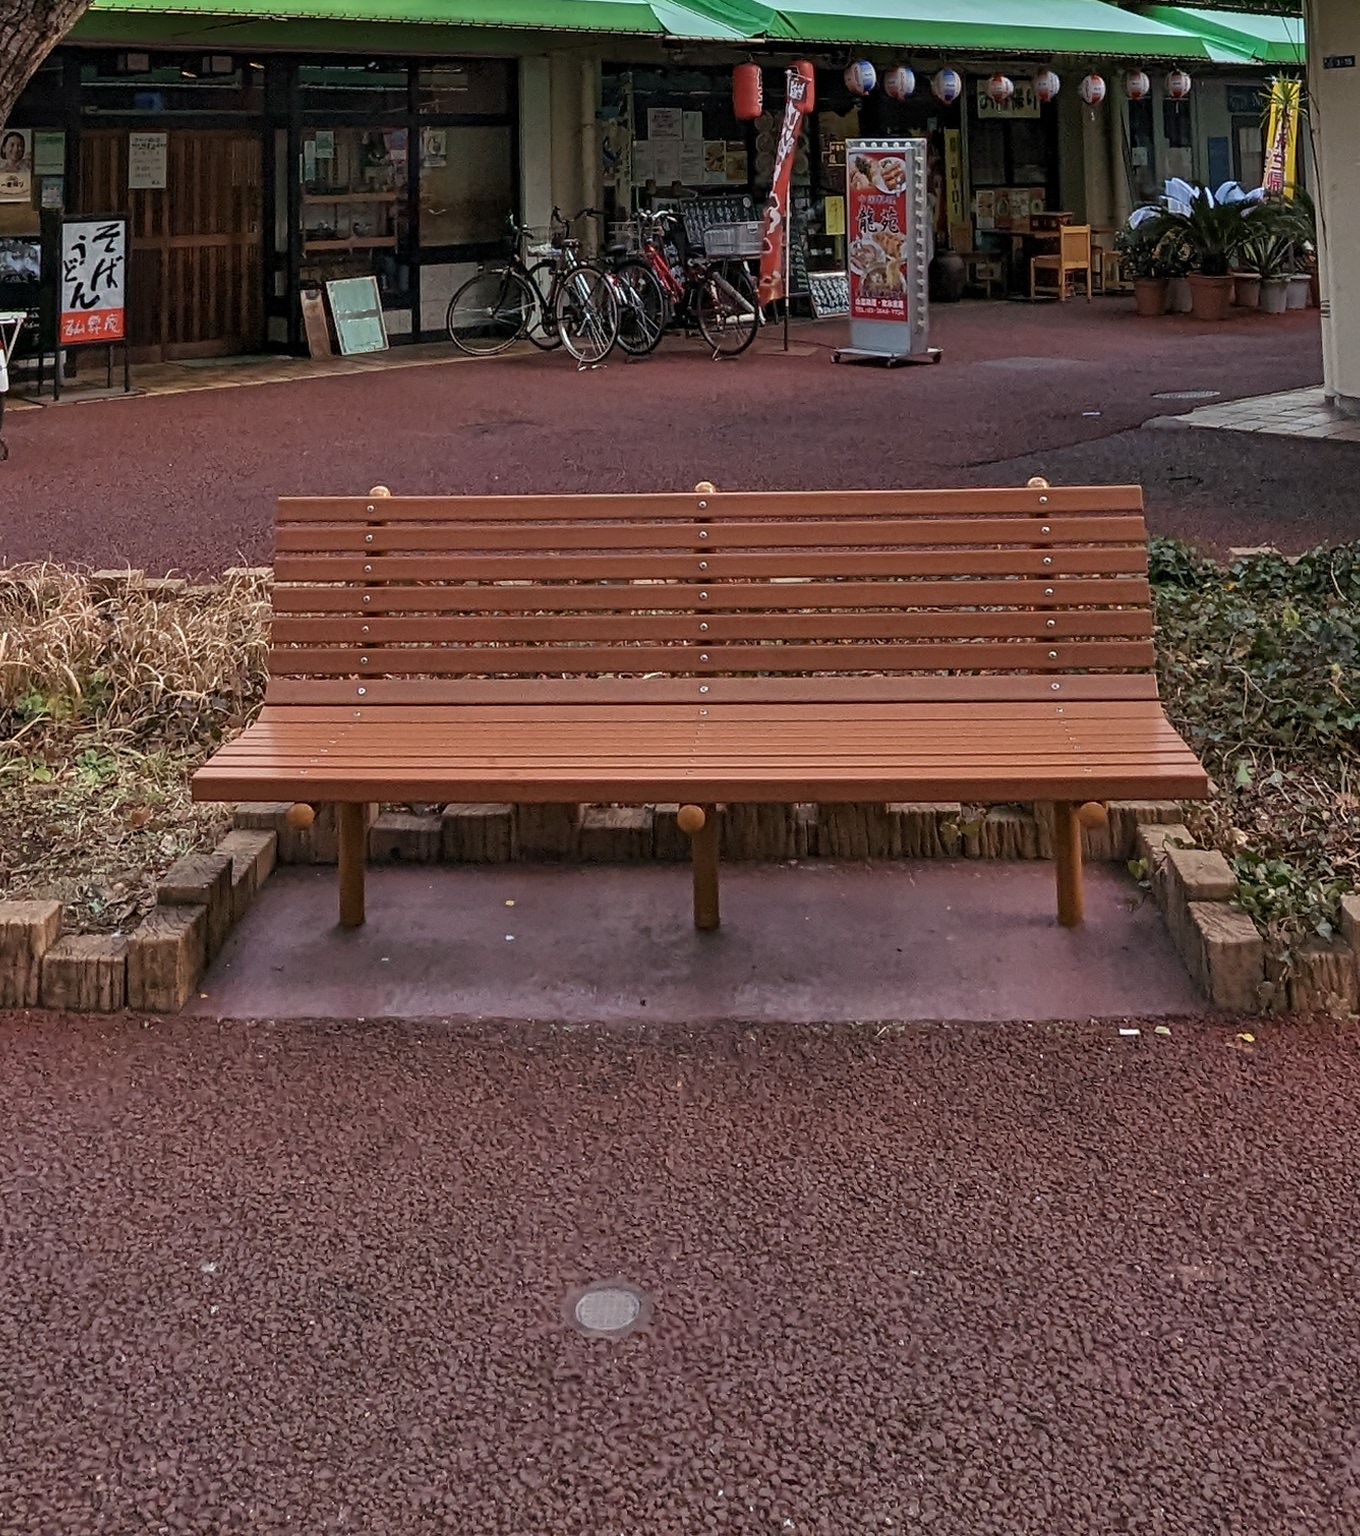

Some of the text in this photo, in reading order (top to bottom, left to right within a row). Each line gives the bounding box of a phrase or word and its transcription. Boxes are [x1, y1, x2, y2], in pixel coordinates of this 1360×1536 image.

[63, 235, 101, 310] うどん
[92, 223, 124, 292] そば
